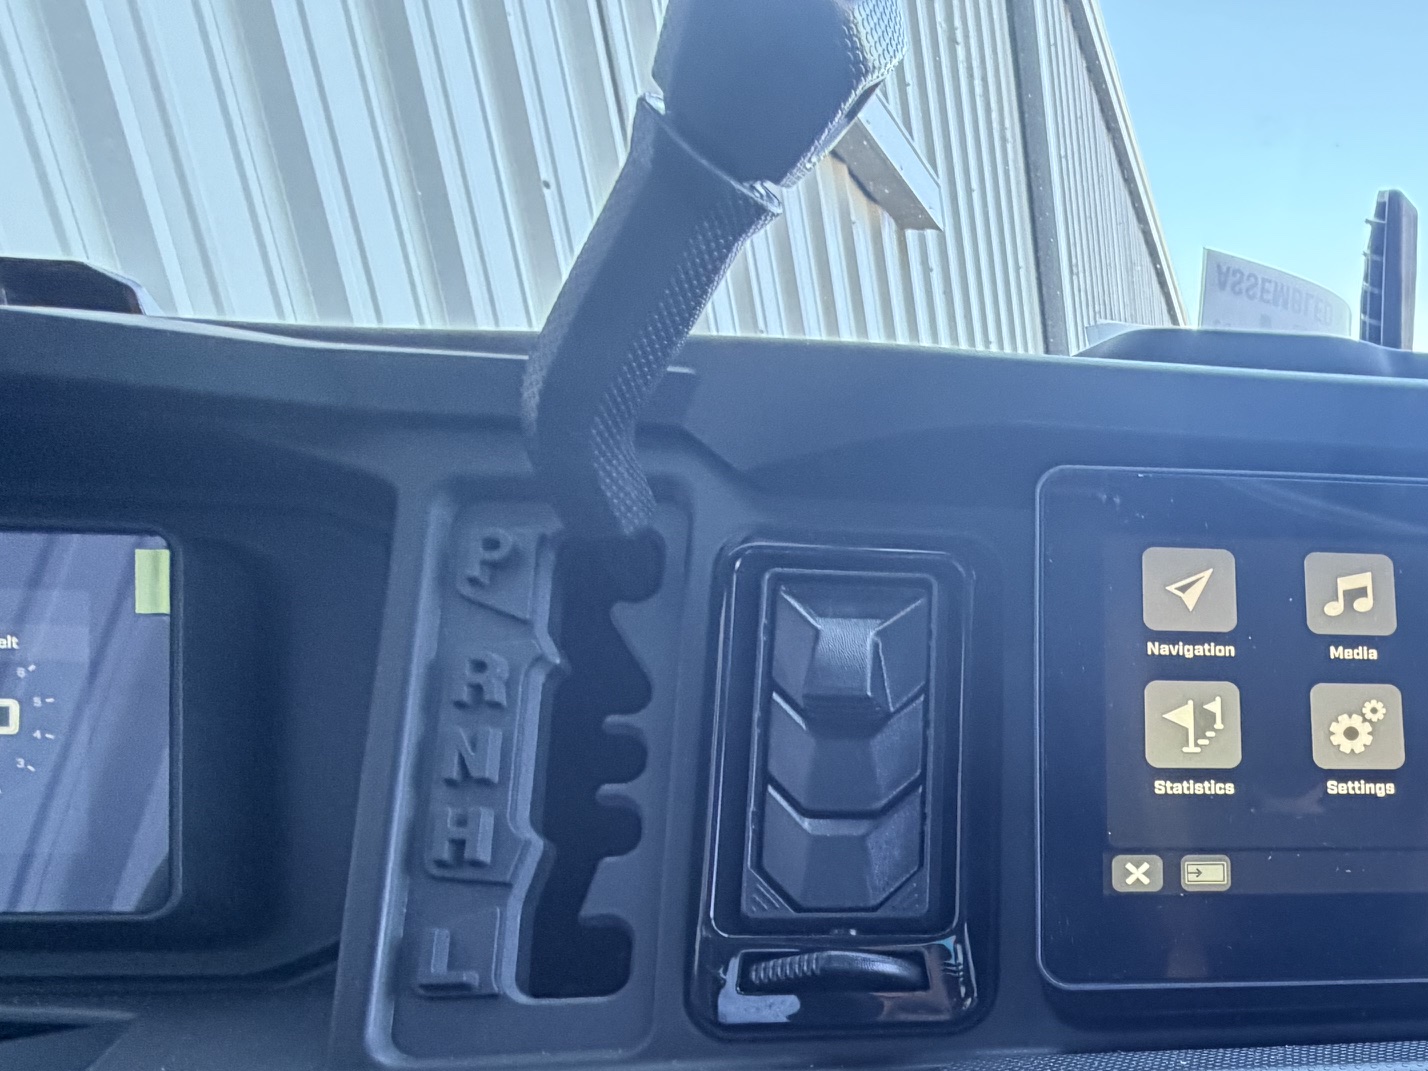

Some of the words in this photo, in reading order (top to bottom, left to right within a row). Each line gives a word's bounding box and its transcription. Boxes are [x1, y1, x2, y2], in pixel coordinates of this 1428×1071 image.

[467, 528, 515, 587] P
[1146, 641, 1236, 658] Navigation
[1329, 645, 1378, 661] Media
[453, 652, 509, 709] R
[33, 696, 42, 707] 5
[32, 730, 42, 739] 4
[16, 758, 25, 768] 3
[443, 727, 502, 785] N
[1154, 780, 1236, 796] Statistics
[1326, 780, 1396, 798] Settings
[432, 807, 495, 868] H
[417, 929, 480, 992] L
